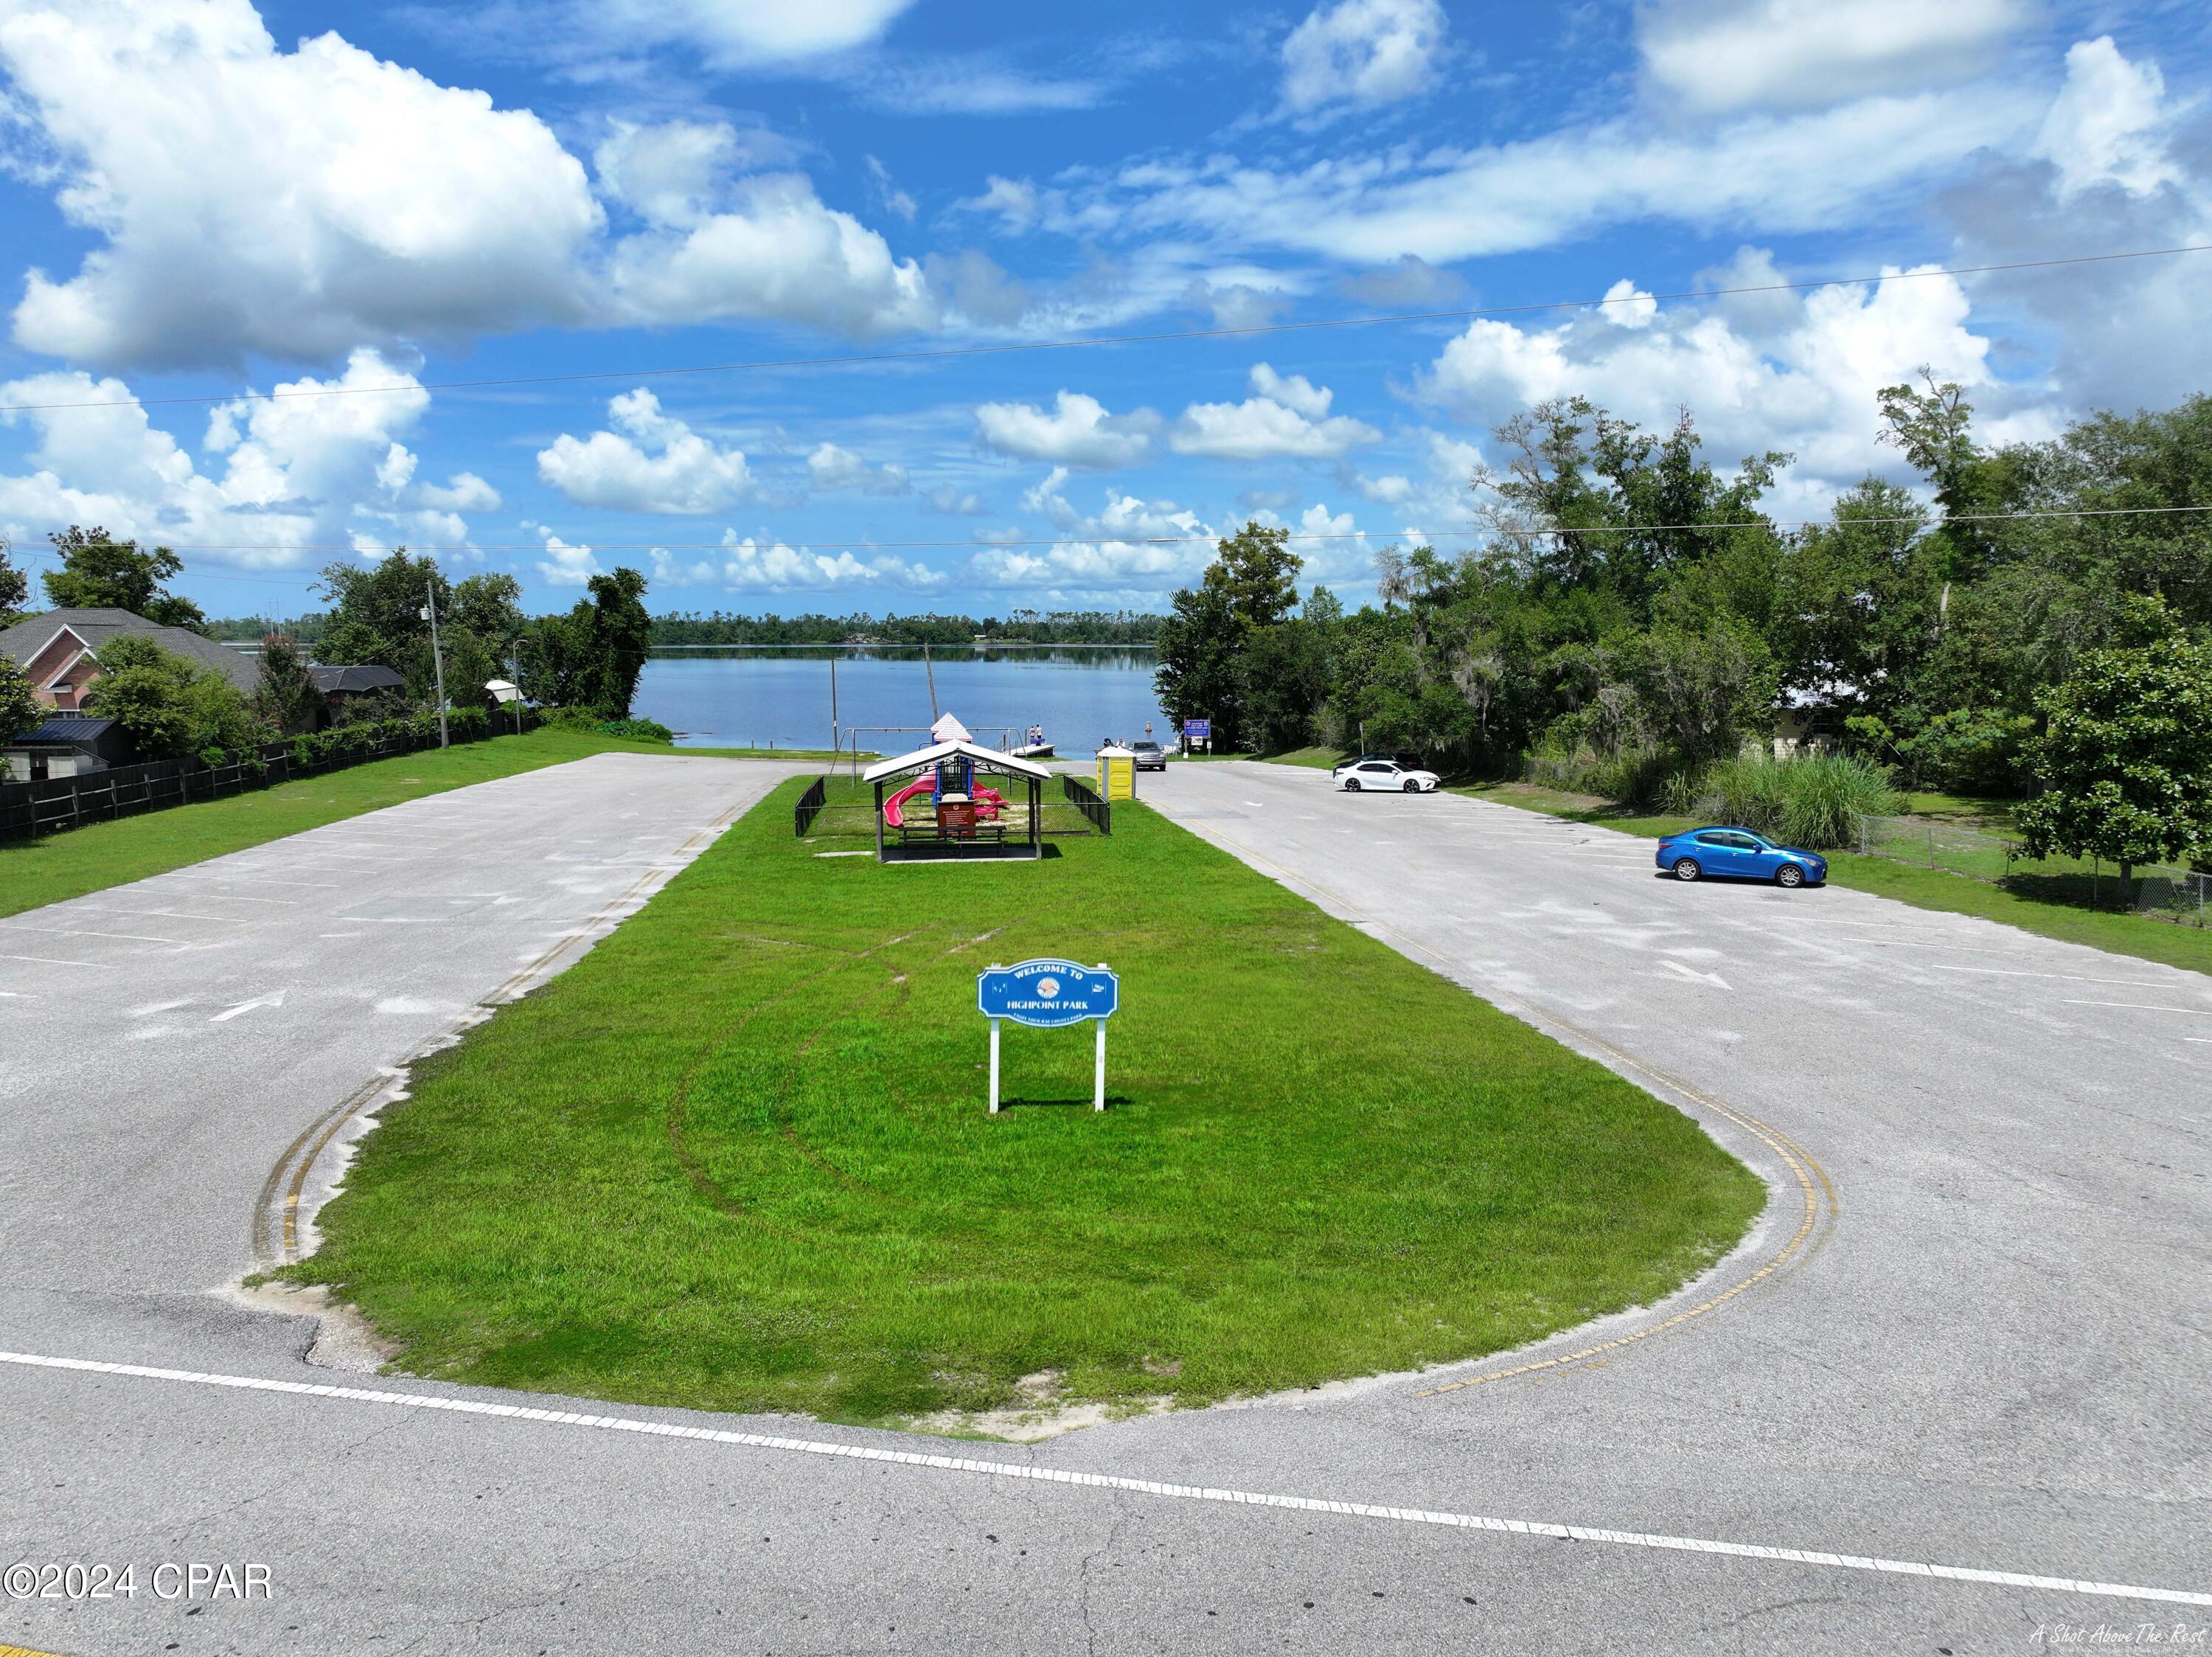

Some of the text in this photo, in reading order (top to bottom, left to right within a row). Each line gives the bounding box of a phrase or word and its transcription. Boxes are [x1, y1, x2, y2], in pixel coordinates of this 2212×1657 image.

[1014, 965, 1083, 980] WELCOME TO
[1006, 1000, 1088, 1010] HIGHPOINT PARK
